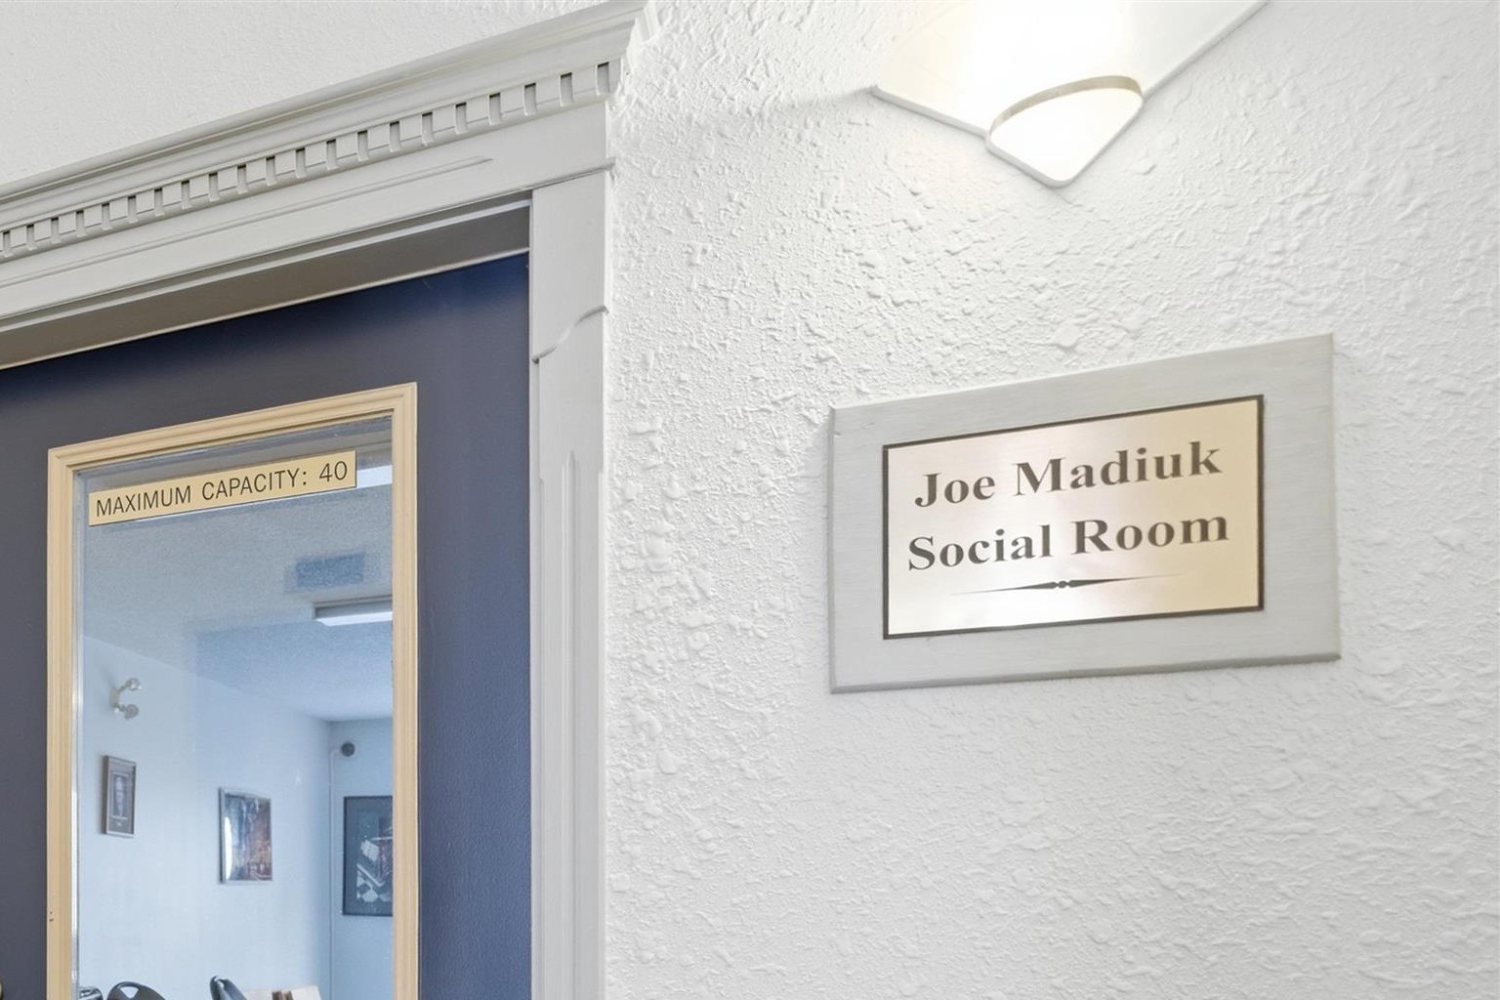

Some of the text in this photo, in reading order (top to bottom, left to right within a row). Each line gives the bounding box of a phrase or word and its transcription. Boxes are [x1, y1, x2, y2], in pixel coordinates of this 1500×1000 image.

[95, 460, 348, 518] MAXIMUM CAPACITY: 40
[914, 440, 1223, 508] Joe Madiuk
[908, 514, 1231, 572] Social Room
